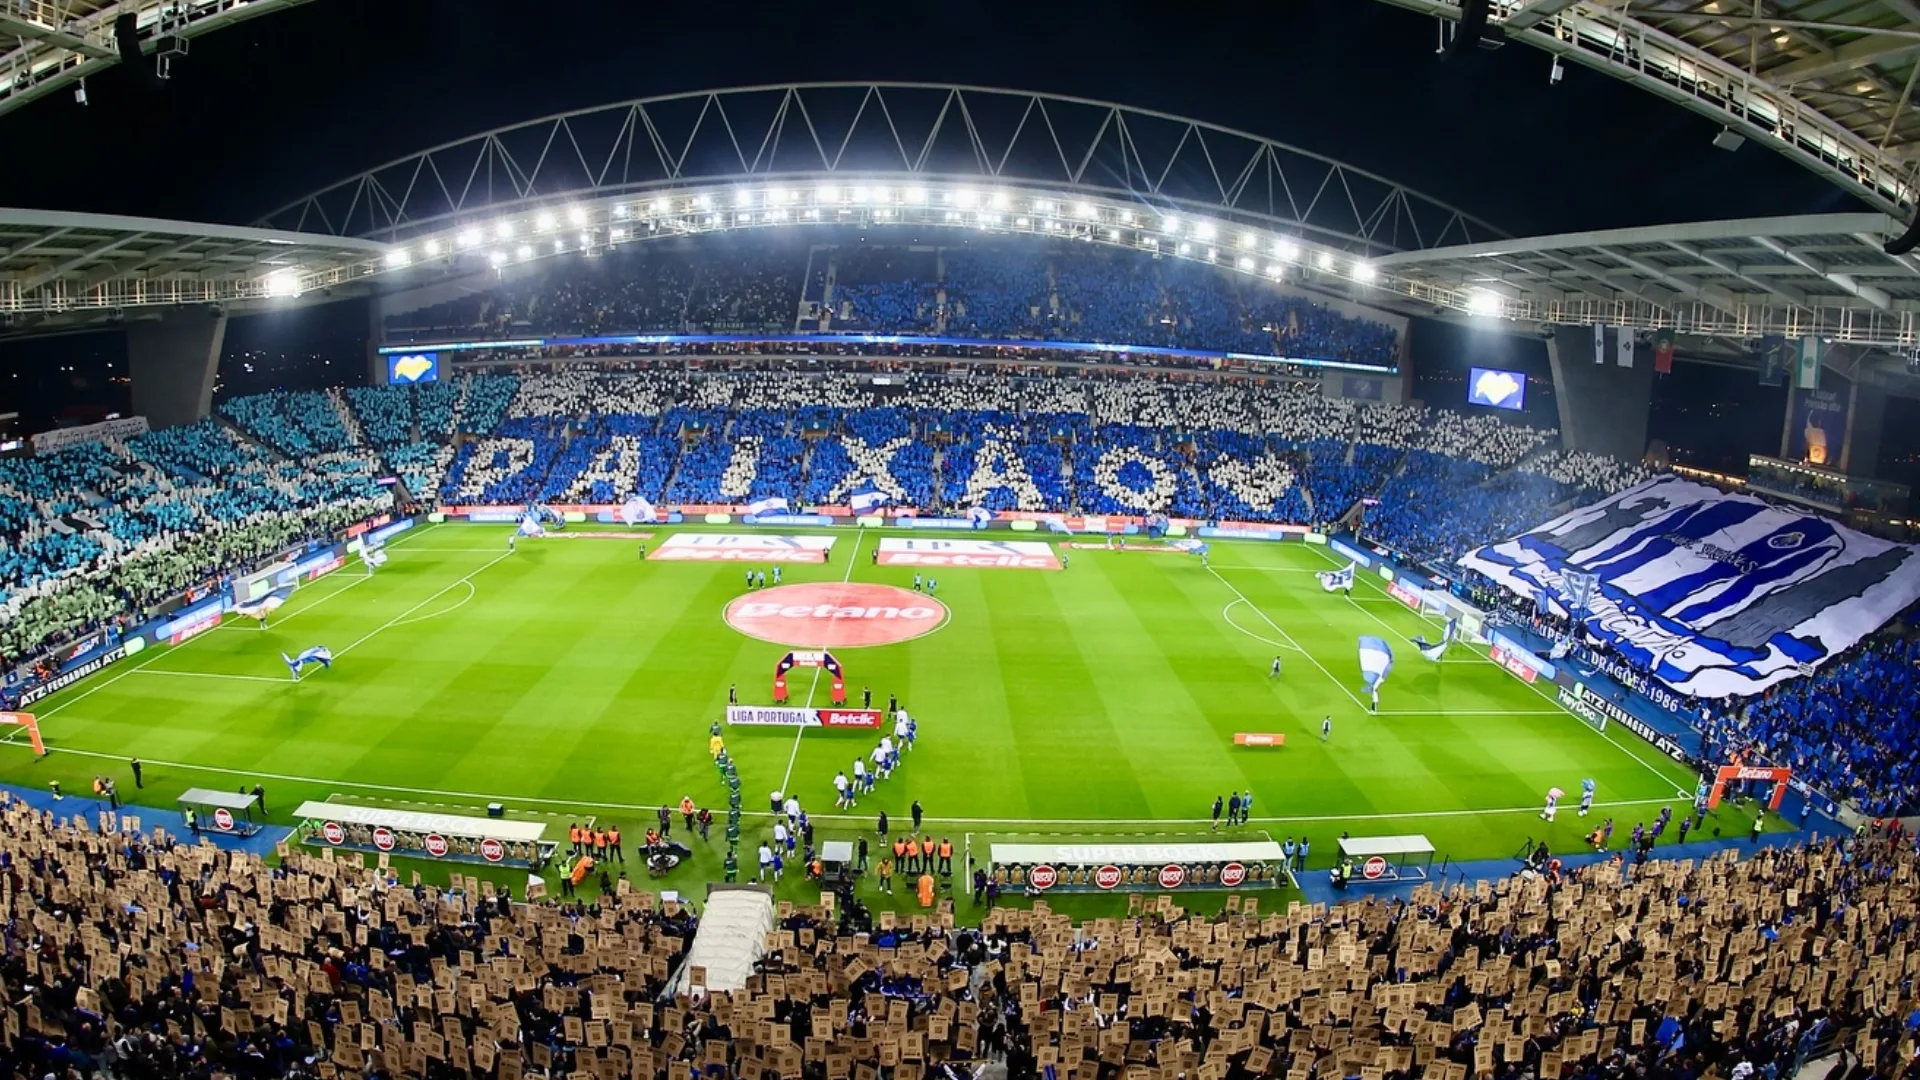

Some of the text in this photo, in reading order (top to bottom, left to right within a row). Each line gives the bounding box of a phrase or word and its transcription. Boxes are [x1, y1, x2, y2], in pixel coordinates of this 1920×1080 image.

[888, 553, 1048, 567] Betclic
[735, 603, 935, 619] Betano
[20, 686, 47, 708] ATZ
[47, 659, 102, 694] FECHADURAS
[102, 647, 126, 666] ATZ
[732, 709, 875, 725] LIGA PORTUGAL Betclic
[1582, 690, 1685, 760] ATZ FERRAGENS ATZ
[1737, 766, 1773, 779] Betano
[344, 808, 478, 832] SUPER BOCK
[1056, 846, 1223, 860] SUPER BOCK
